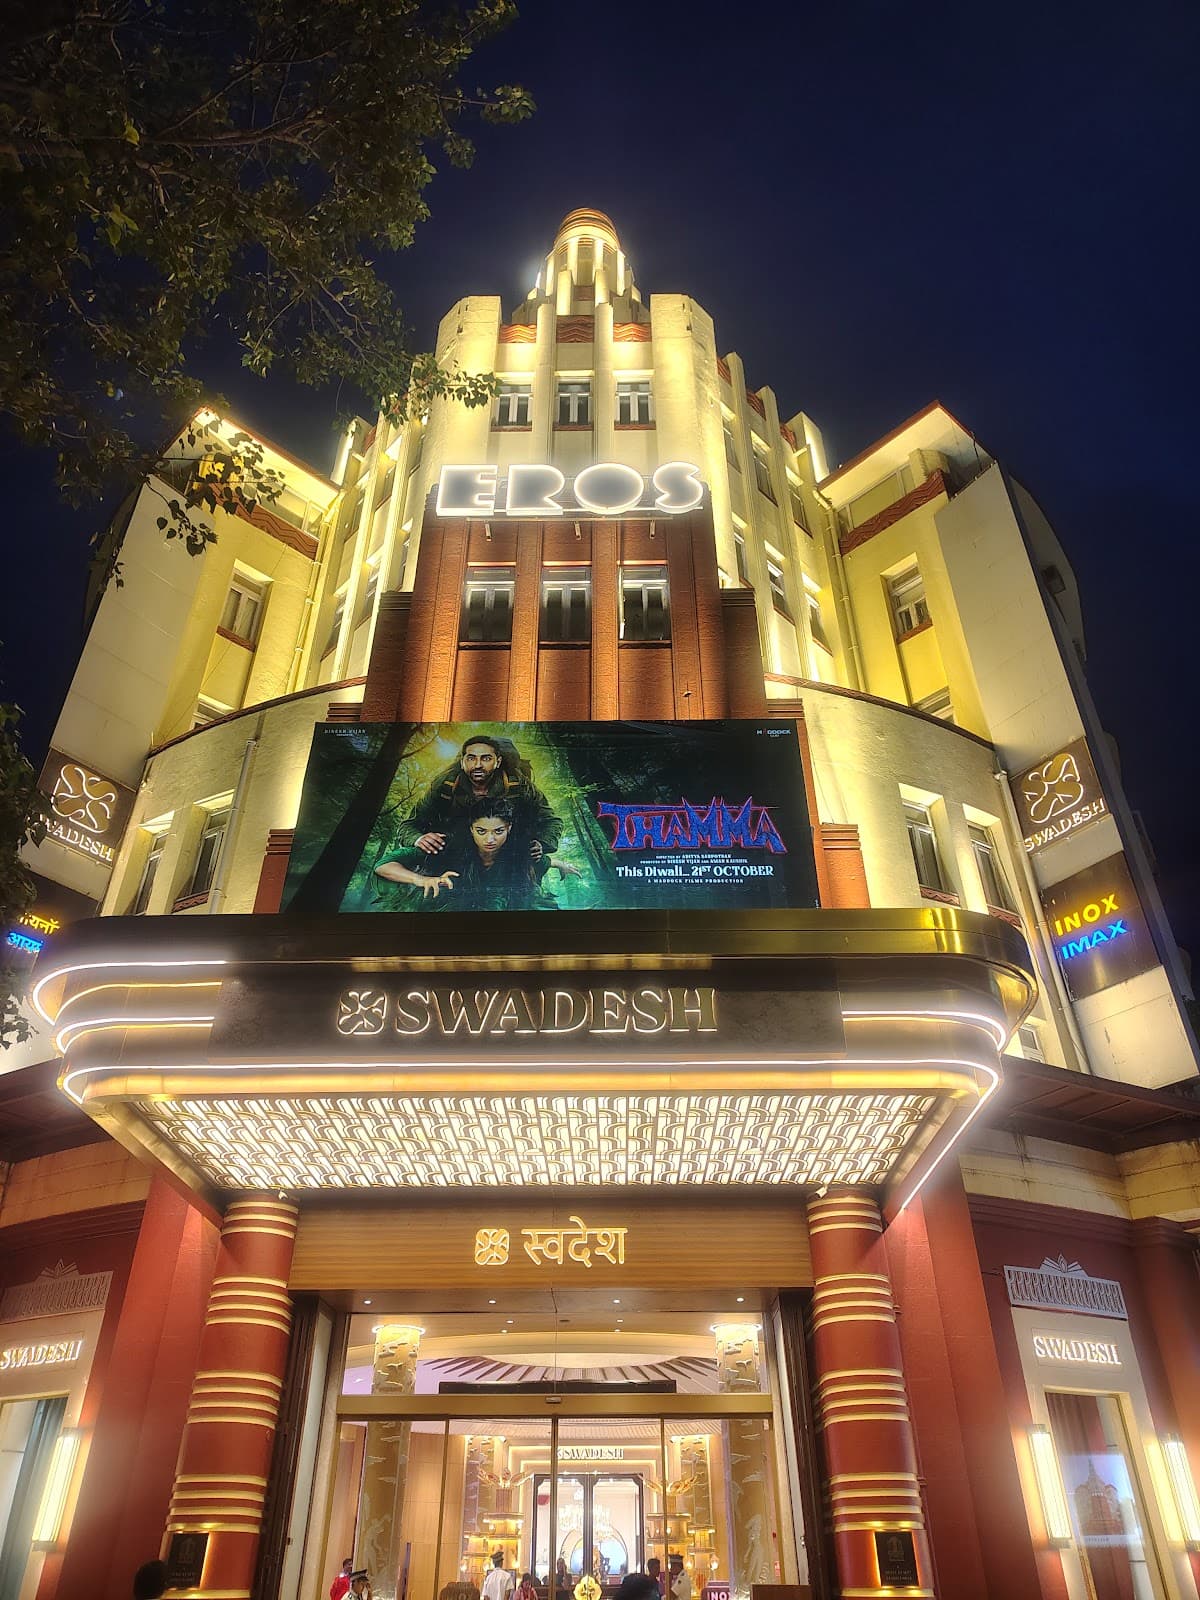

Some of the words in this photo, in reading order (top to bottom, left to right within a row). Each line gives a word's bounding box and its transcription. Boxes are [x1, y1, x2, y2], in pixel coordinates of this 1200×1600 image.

[436, 461, 704, 516] EROS
[597, 796, 788, 854] THAMMA
[1024, 798, 1106, 853] SWADESH
[616, 866, 643, 877] This
[713, 865, 774, 877] OCTOBER
[1055, 894, 1119, 937] INOX
[1061, 919, 1128, 961] IMAX
[396, 988, 719, 1035] SWADESH
[521, 1216, 628, 1268] स्वदेश
[0, 1339, 82, 1370] SWADESH
[1032, 1335, 1122, 1366] SWADESH
[563, 1447, 624, 1460] SWADESH
